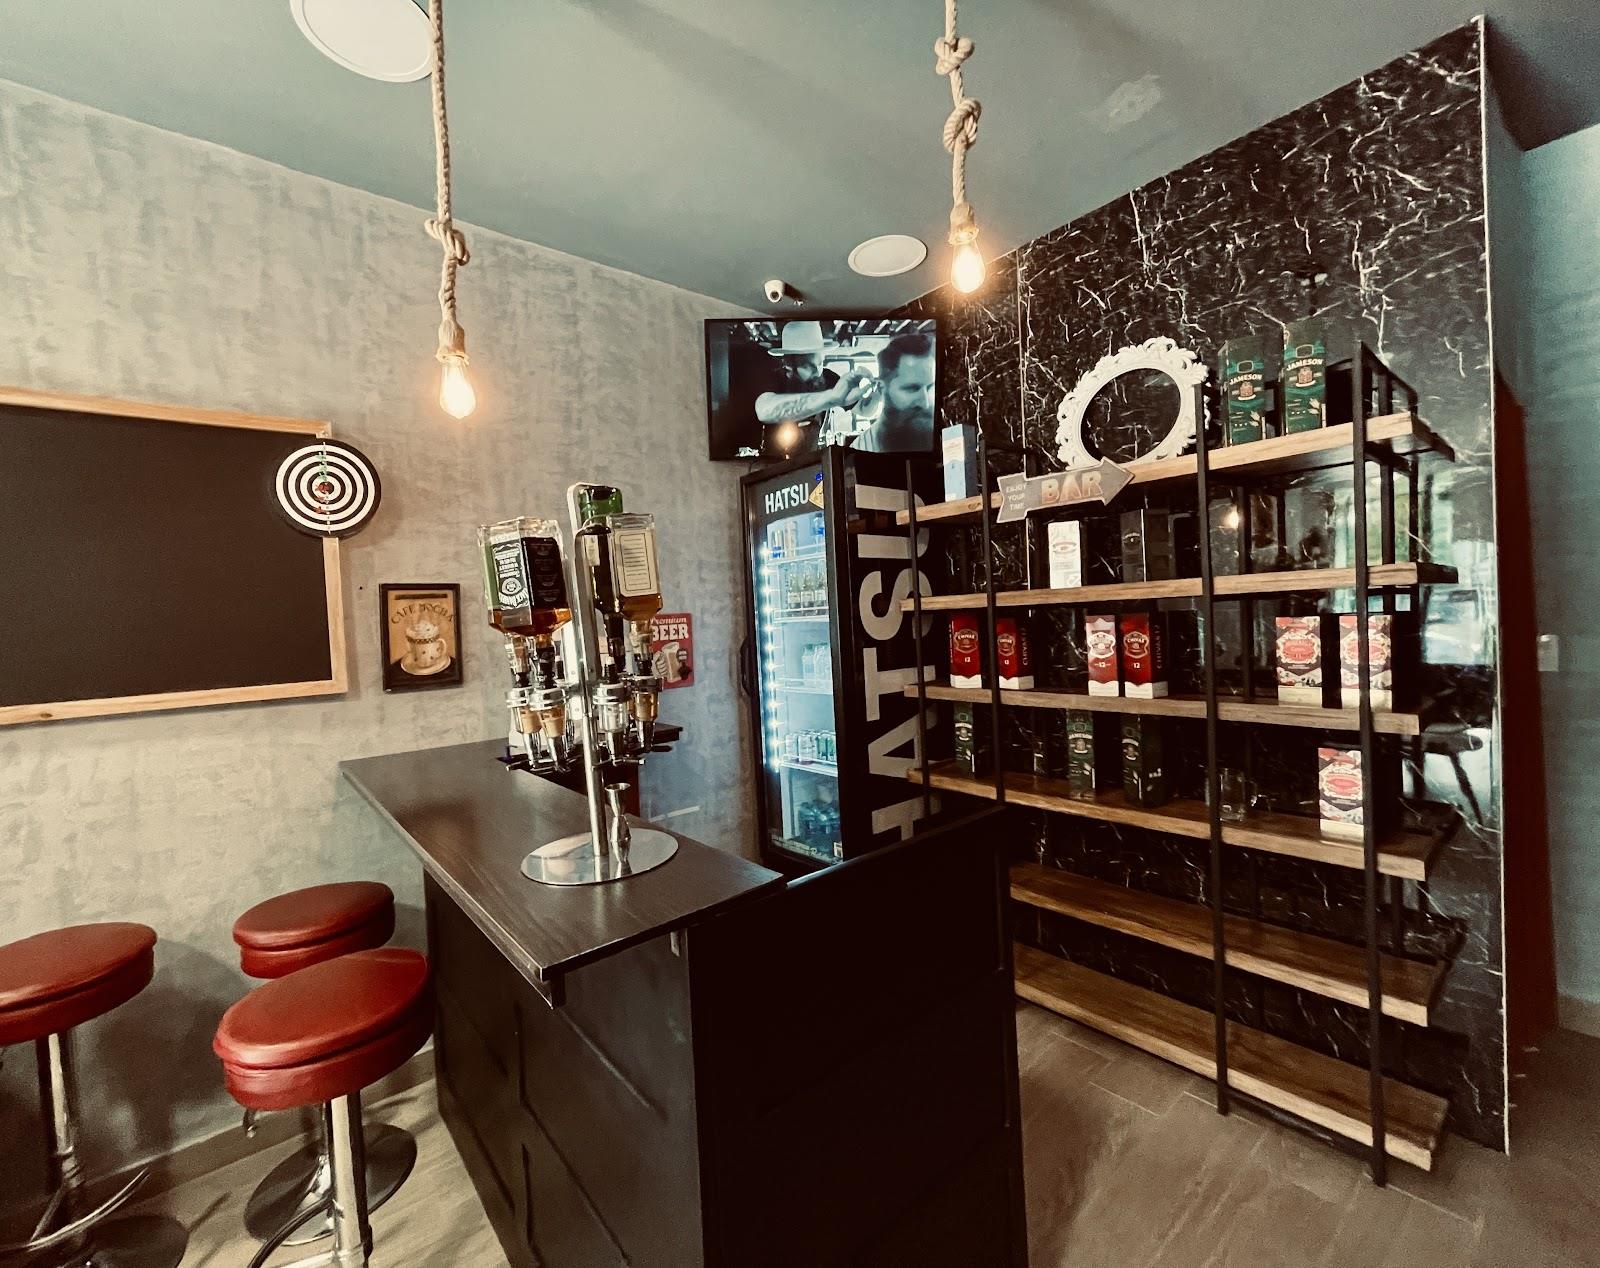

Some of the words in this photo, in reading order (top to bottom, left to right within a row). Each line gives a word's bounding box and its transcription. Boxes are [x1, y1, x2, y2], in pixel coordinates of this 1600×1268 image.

[1286, 359, 1323, 371] JAMESON
[1229, 374, 1262, 385] JAMESON
[1041, 471, 1103, 505] BAR
[765, 482, 809, 514] HATSU
[652, 623, 690, 641] BEER
